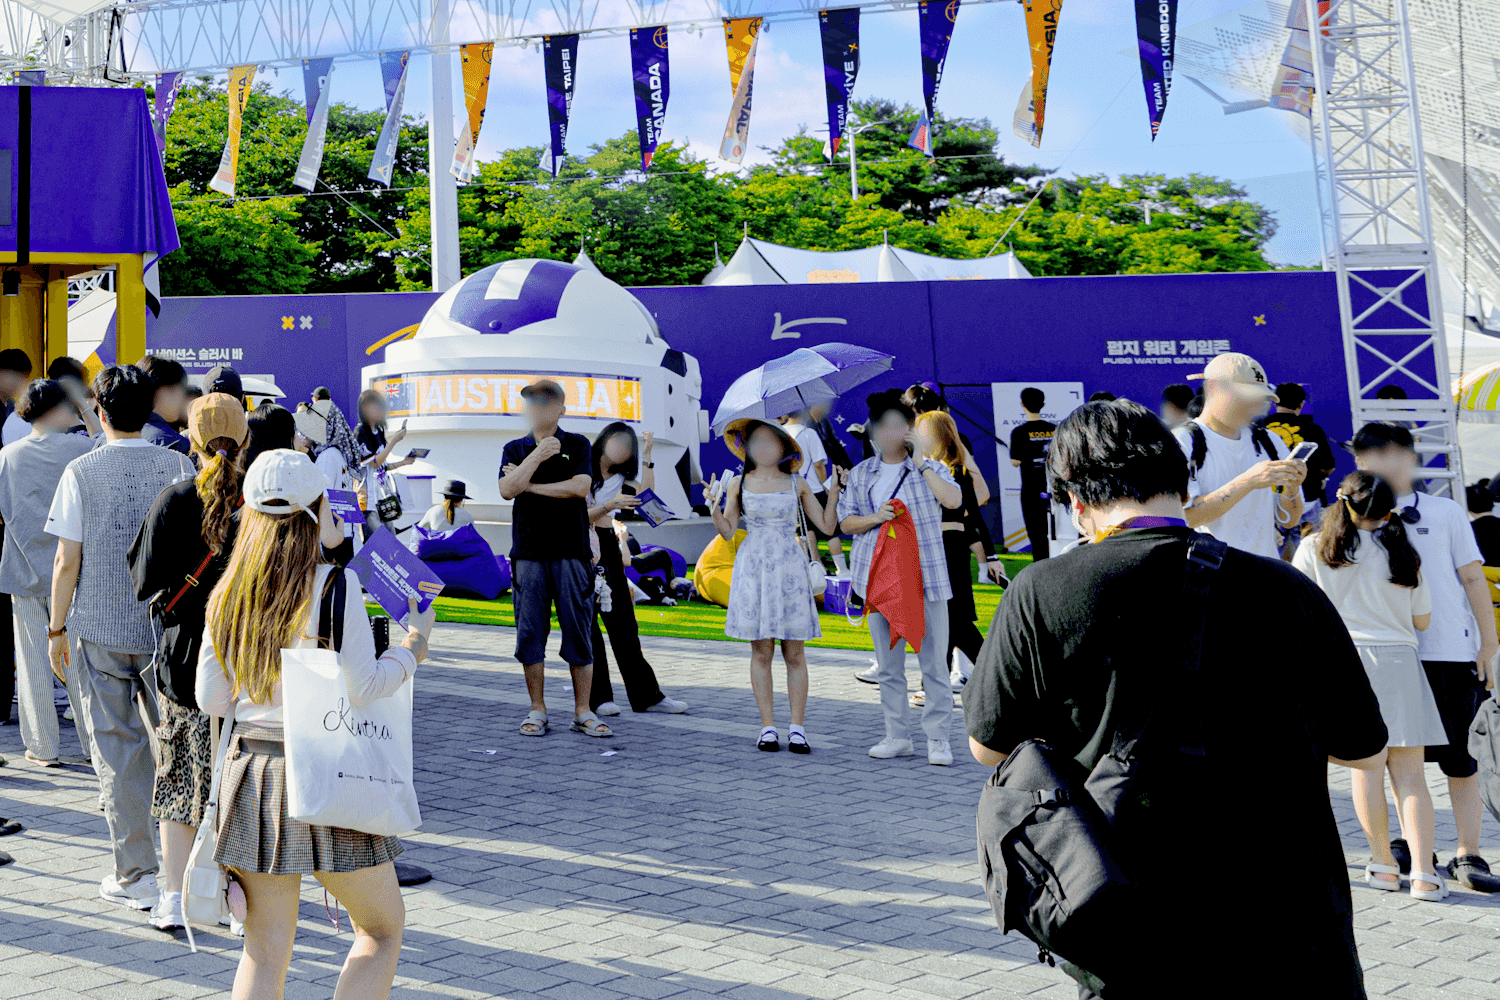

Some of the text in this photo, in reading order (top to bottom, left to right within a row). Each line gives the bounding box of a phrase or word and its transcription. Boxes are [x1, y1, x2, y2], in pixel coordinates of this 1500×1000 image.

[561, 48, 571, 90] TAIPEI
[1163, 60, 1173, 103] ITED
[648, 62, 664, 142] CANADA
[1153, 82, 1163, 112] TEAM
[646, 118, 654, 144] TEAM
[837, 104, 845, 131] TEAM
[198, 348, 230, 360] 슬러시
[232, 348, 243, 360] 바
[1103, 357, 1133, 365] PUBG
[1135, 357, 1172, 365] WATER
[1173, 357, 1205, 365] GAME
[1106, 339, 1231, 356] 펍지 워터 게임존
[424, 378, 613, 415] AUSTRLIA
